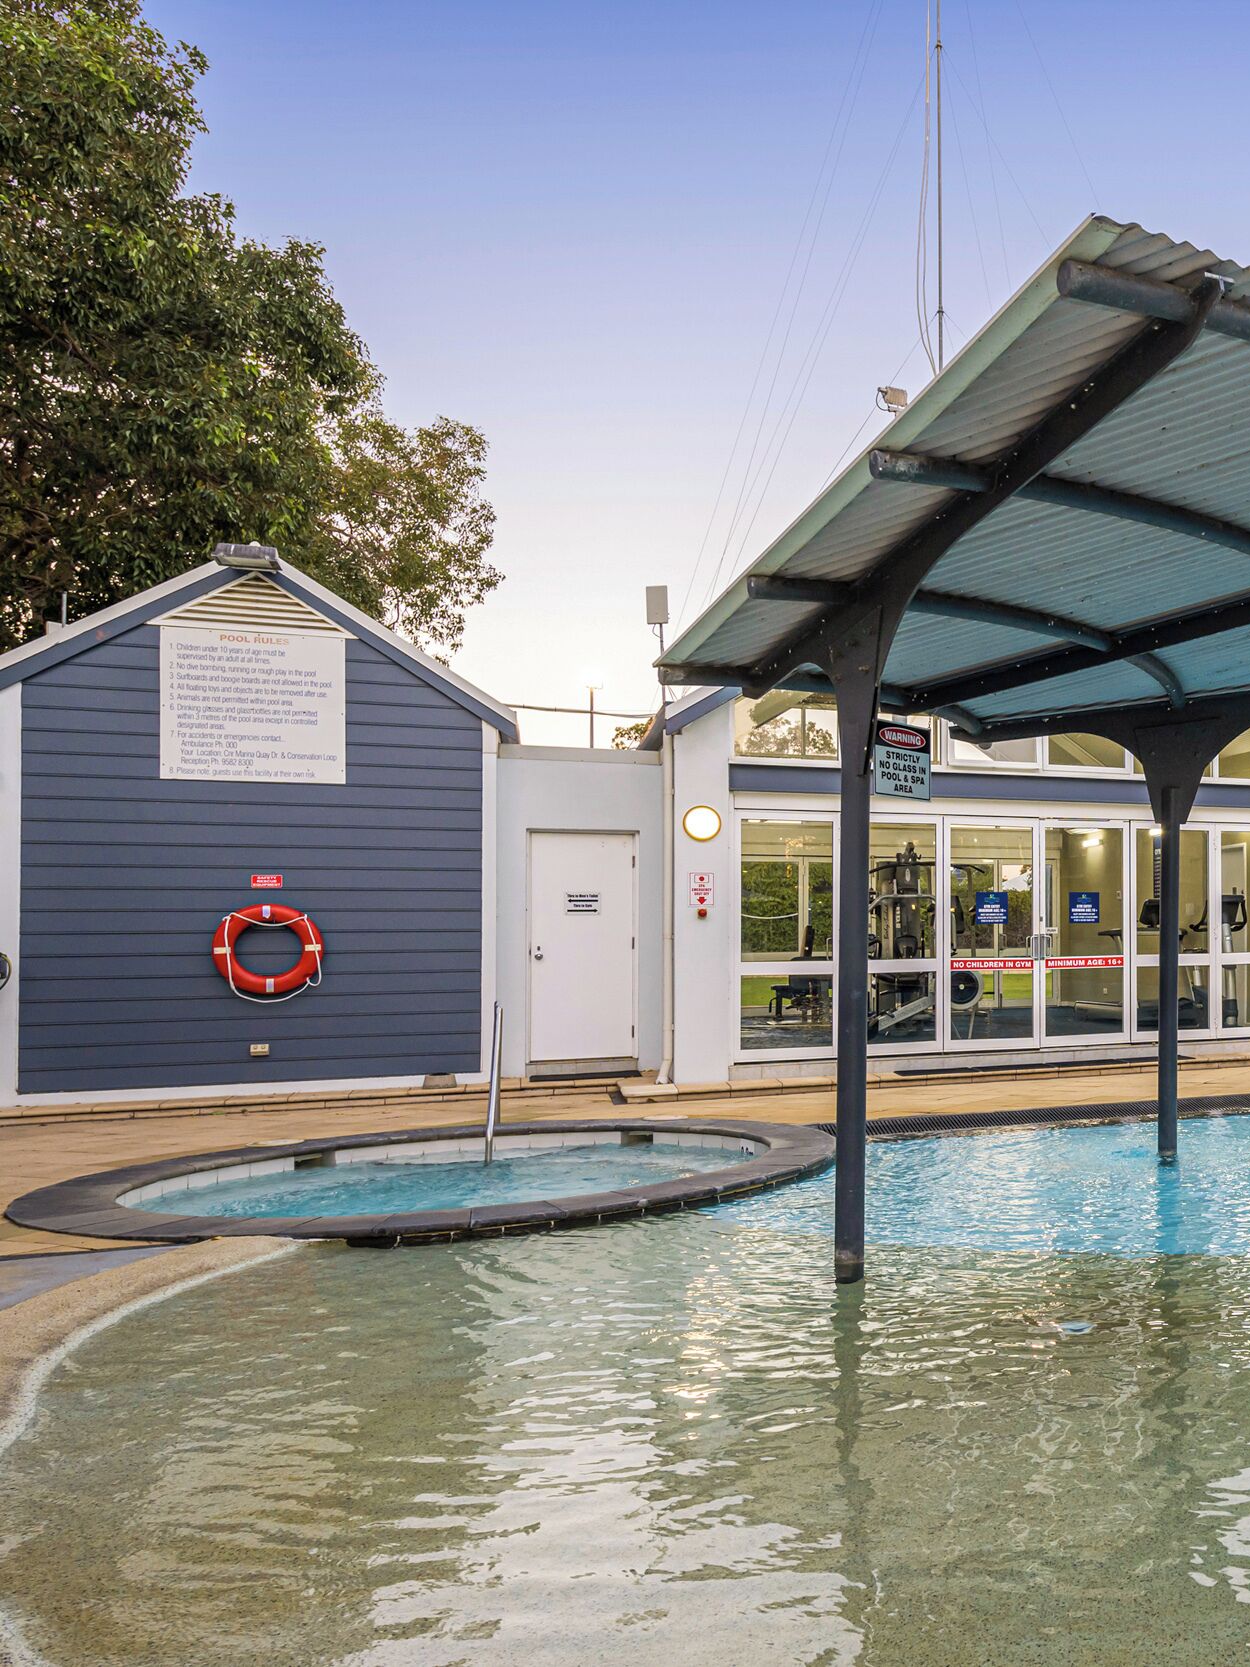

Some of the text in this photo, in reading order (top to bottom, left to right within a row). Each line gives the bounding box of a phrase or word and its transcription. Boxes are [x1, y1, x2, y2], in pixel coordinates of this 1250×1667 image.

[220, 634, 289, 645] POOL RULES
[884, 730, 921, 745] WARNING
[886, 750, 920, 763] STRICTLY
[879, 760, 926, 775] NO GLASS IN
[881, 771, 925, 785] POOL & SPA
[894, 783, 913, 793] AREA
